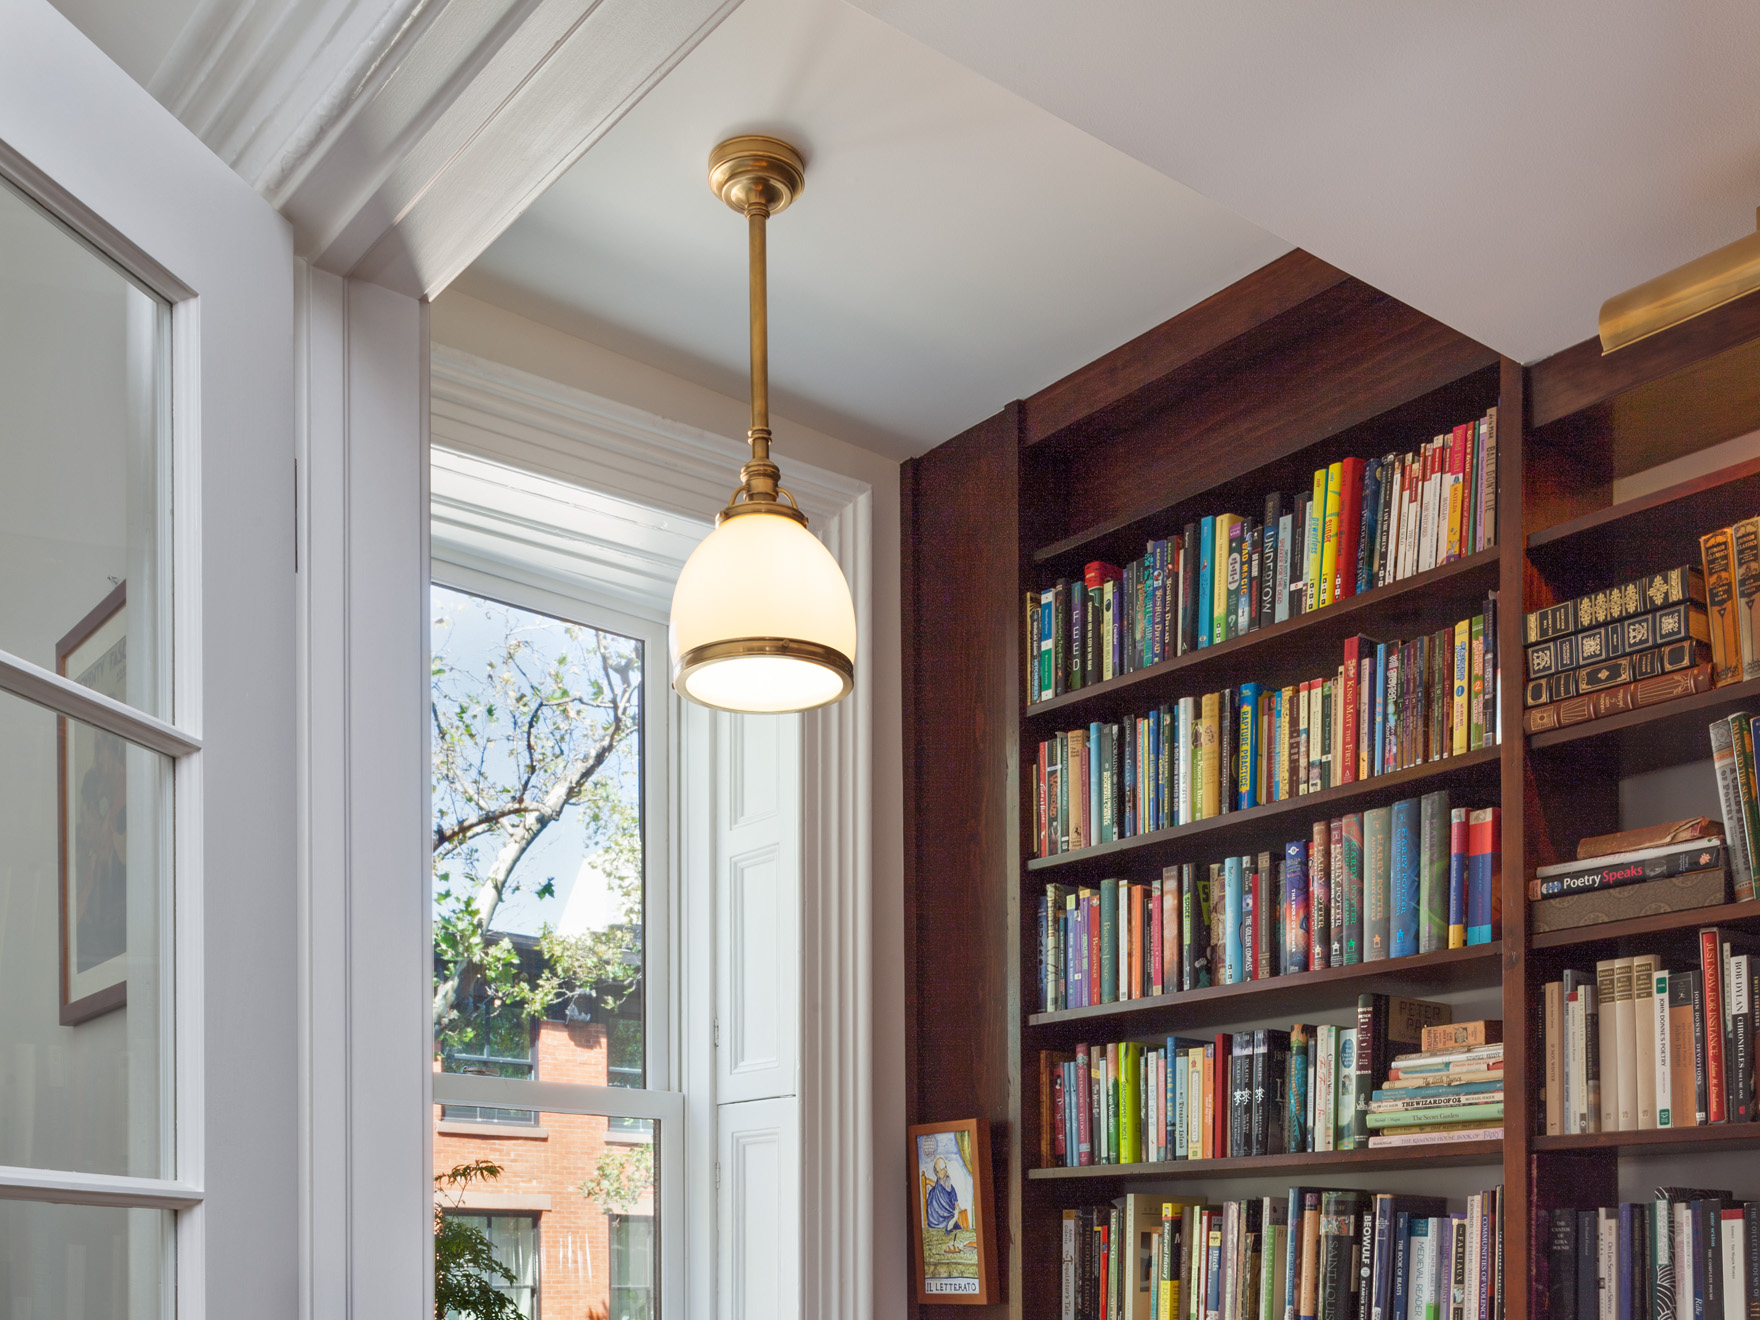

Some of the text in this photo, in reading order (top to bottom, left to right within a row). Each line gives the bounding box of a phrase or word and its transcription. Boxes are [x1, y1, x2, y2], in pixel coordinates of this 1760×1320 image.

[1453, 453, 1462, 472] Dahl
[1455, 430, 1463, 450] Roald
[1485, 446, 1496, 512] BALL DON'T LIE
[1311, 517, 1320, 554] powerless
[1262, 532, 1274, 613] UNDERTOW
[1346, 680, 1354, 702] KING
[1240, 710, 1249, 788] RAPTURE PRACTICE
[1732, 720, 1749, 802] TALKING TO THE SUN
[1563, 865, 1643, 890] Poetry Speaks
[1706, 943, 1718, 1056] JUST NOW, FOR INSTANCE
[1735, 983, 1743, 1012] DYLAN
[1737, 1017, 1745, 1068] CHRONICLES
[1362, 1215, 1371, 1264] BEOWULF
[1456, 1236, 1464, 1281] FABLIAUX
[926, 1283, 976, 1292] IL LETTERATO
[1326, 1240, 1338, 1320] SAINT LOUIS
[1415, 1241, 1424, 1316] MEDIEVAL READER
[1481, 1273, 1486, 1282] OF
[1695, 1297, 1703, 1315] Rilke
